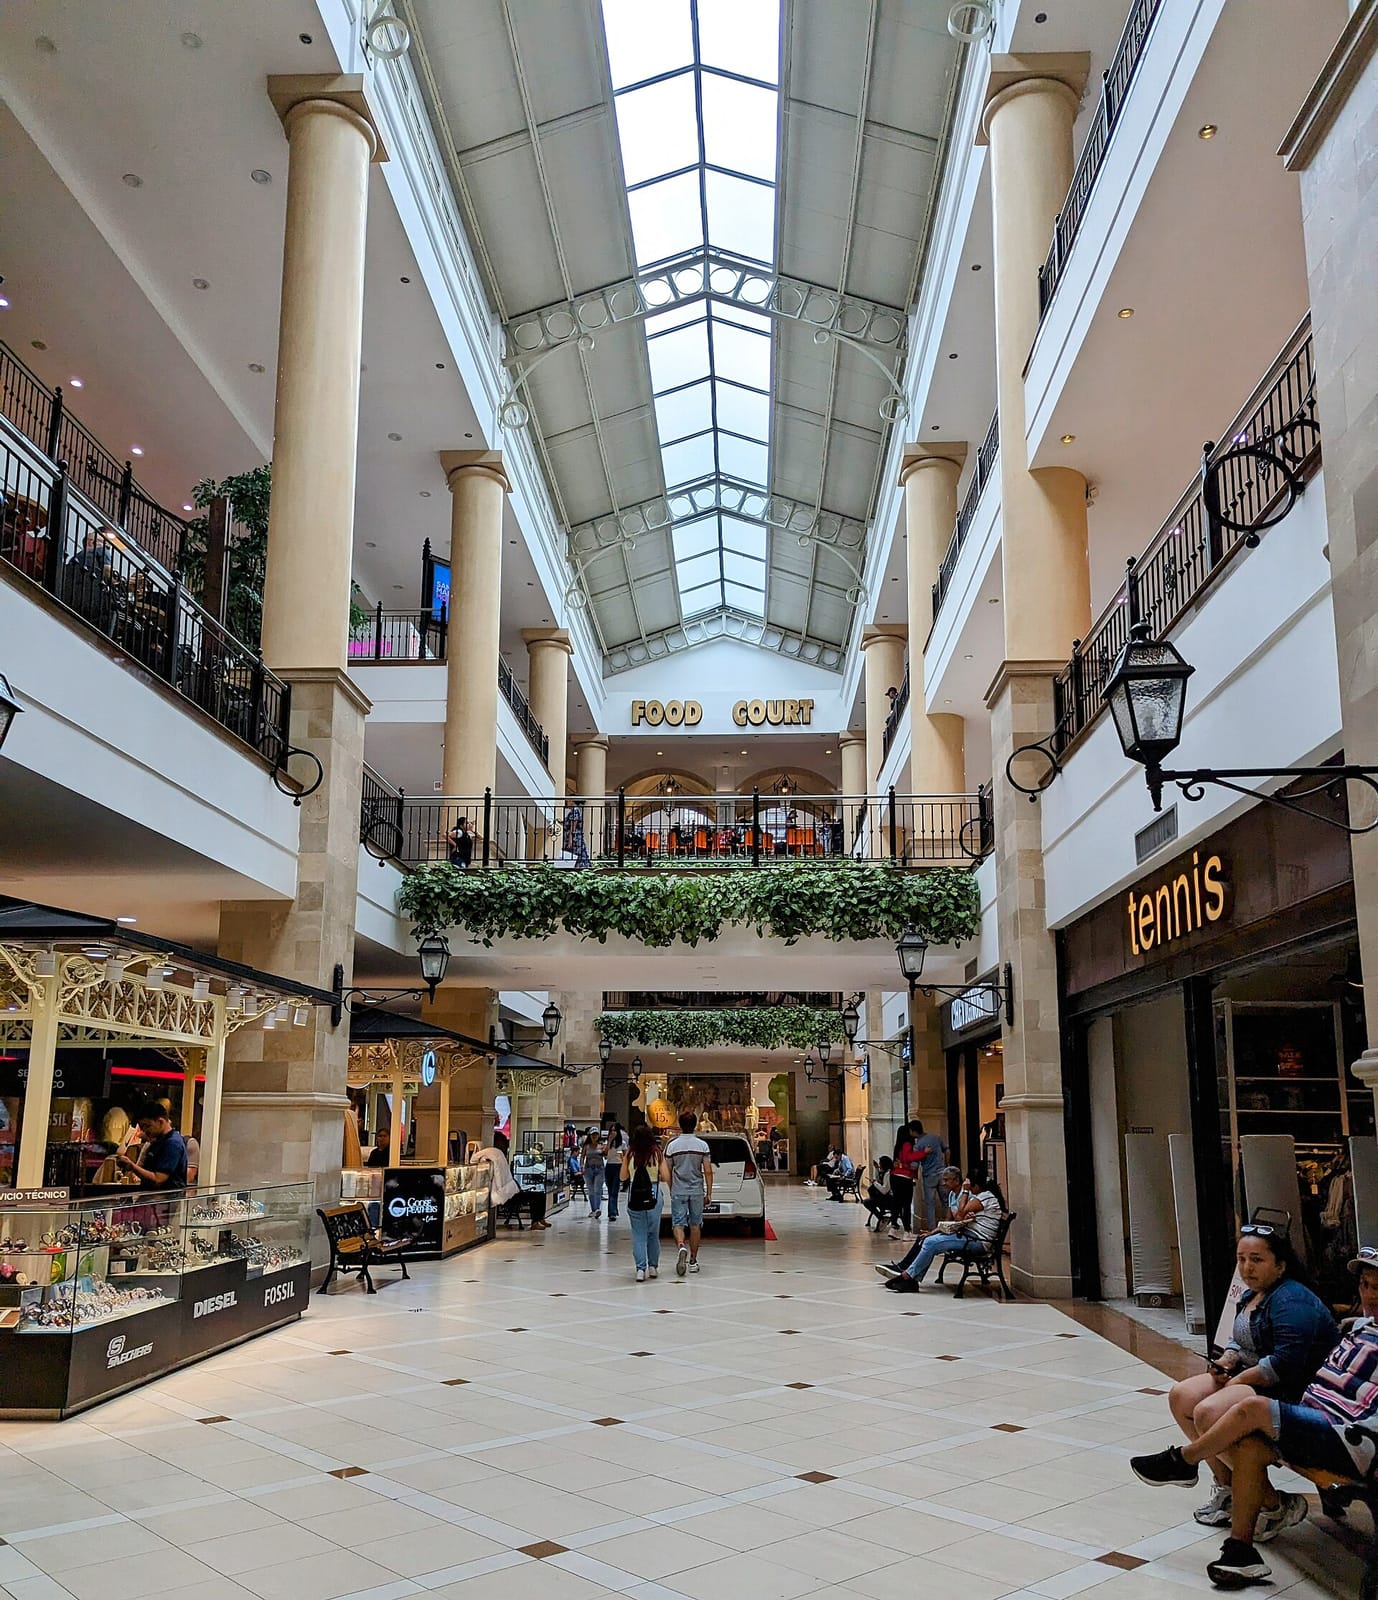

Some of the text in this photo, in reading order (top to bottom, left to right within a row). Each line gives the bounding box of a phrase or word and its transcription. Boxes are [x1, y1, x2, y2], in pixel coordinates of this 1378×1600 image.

[631, 699, 814, 726] FOOD COURT
[1128, 851, 1225, 956] tennis
[25, 1189, 67, 1200] TÉCNICO
[194, 1291, 238, 1319] DIESEL
[264, 1280, 295, 1307] FOSSIL
[107, 1342, 154, 1369] SKECHERS
